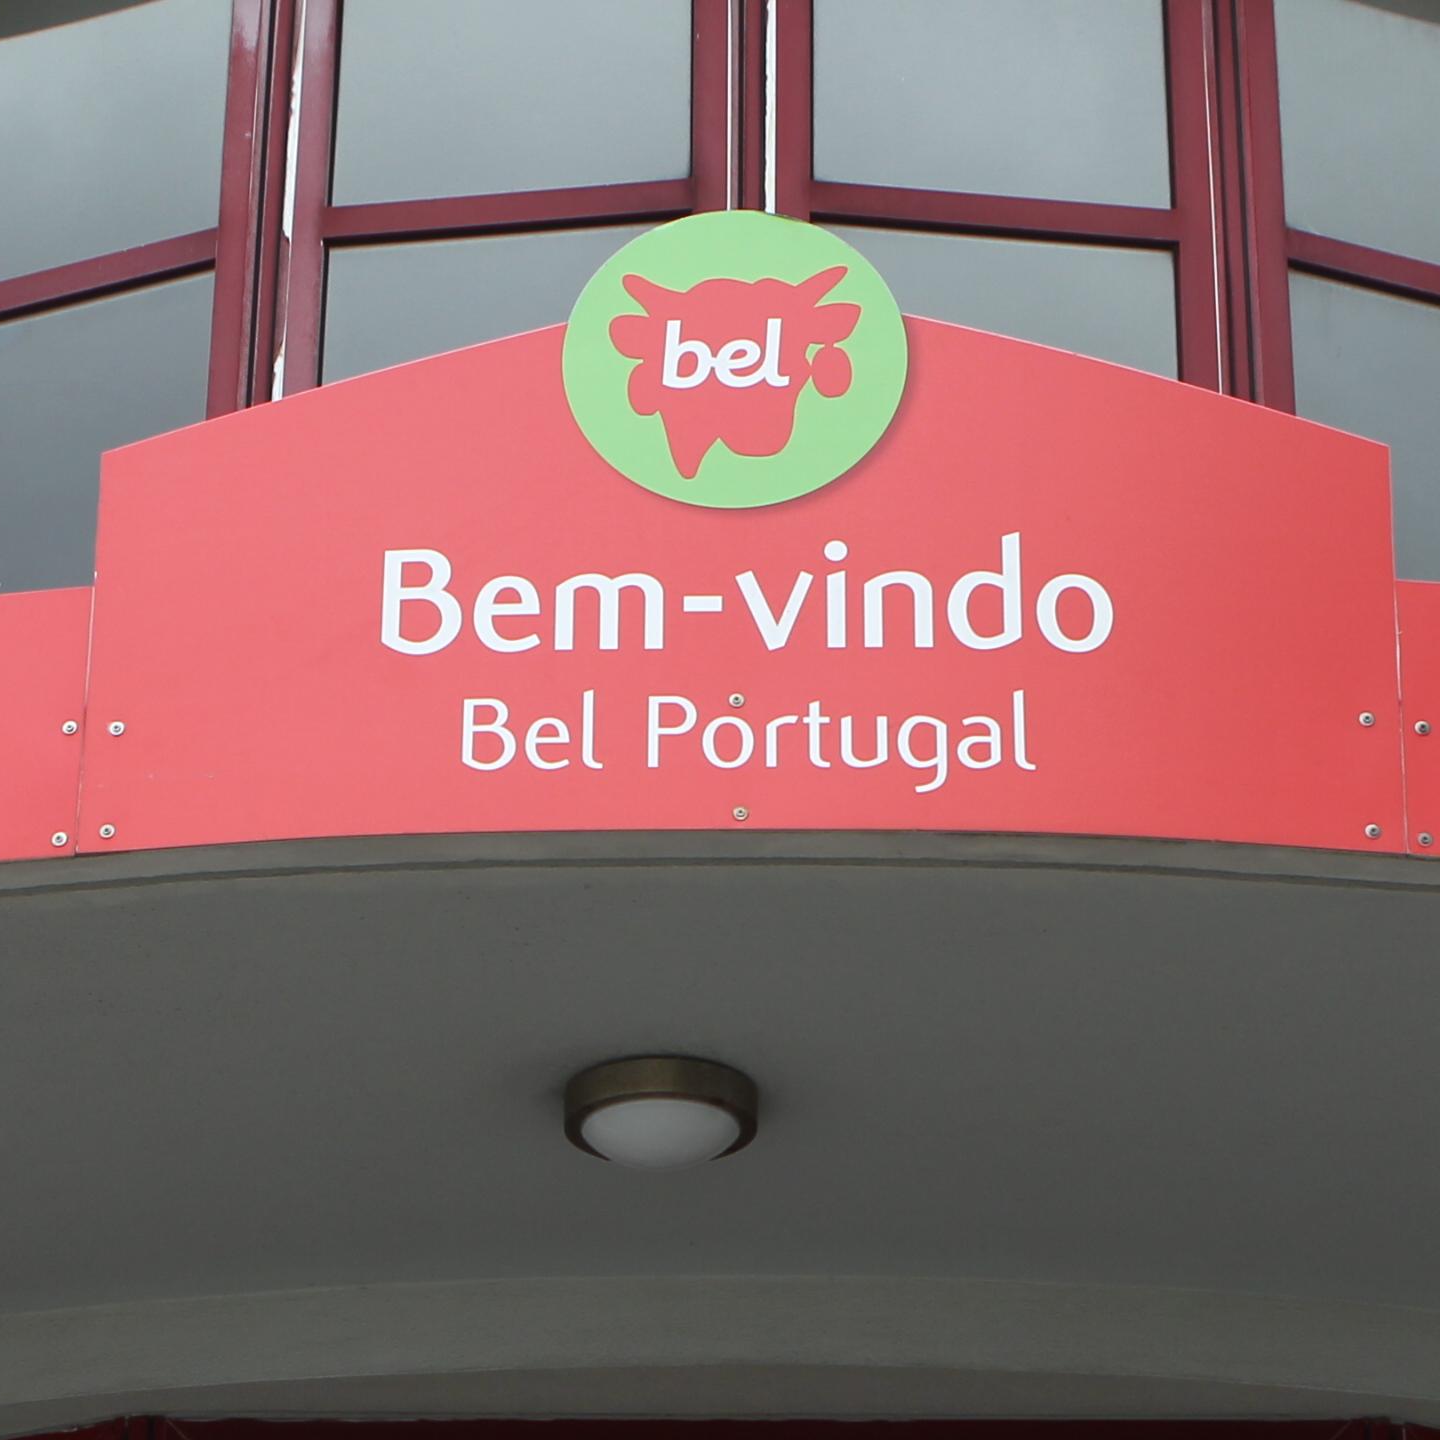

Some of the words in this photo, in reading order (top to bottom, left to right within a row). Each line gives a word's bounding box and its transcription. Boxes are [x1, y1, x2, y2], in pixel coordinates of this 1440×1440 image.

[662, 318, 791, 389] bel
[380, 532, 1114, 655] Bem-vindo
[461, 690, 603, 771] Bel
[647, 689, 1037, 794] Portugal
